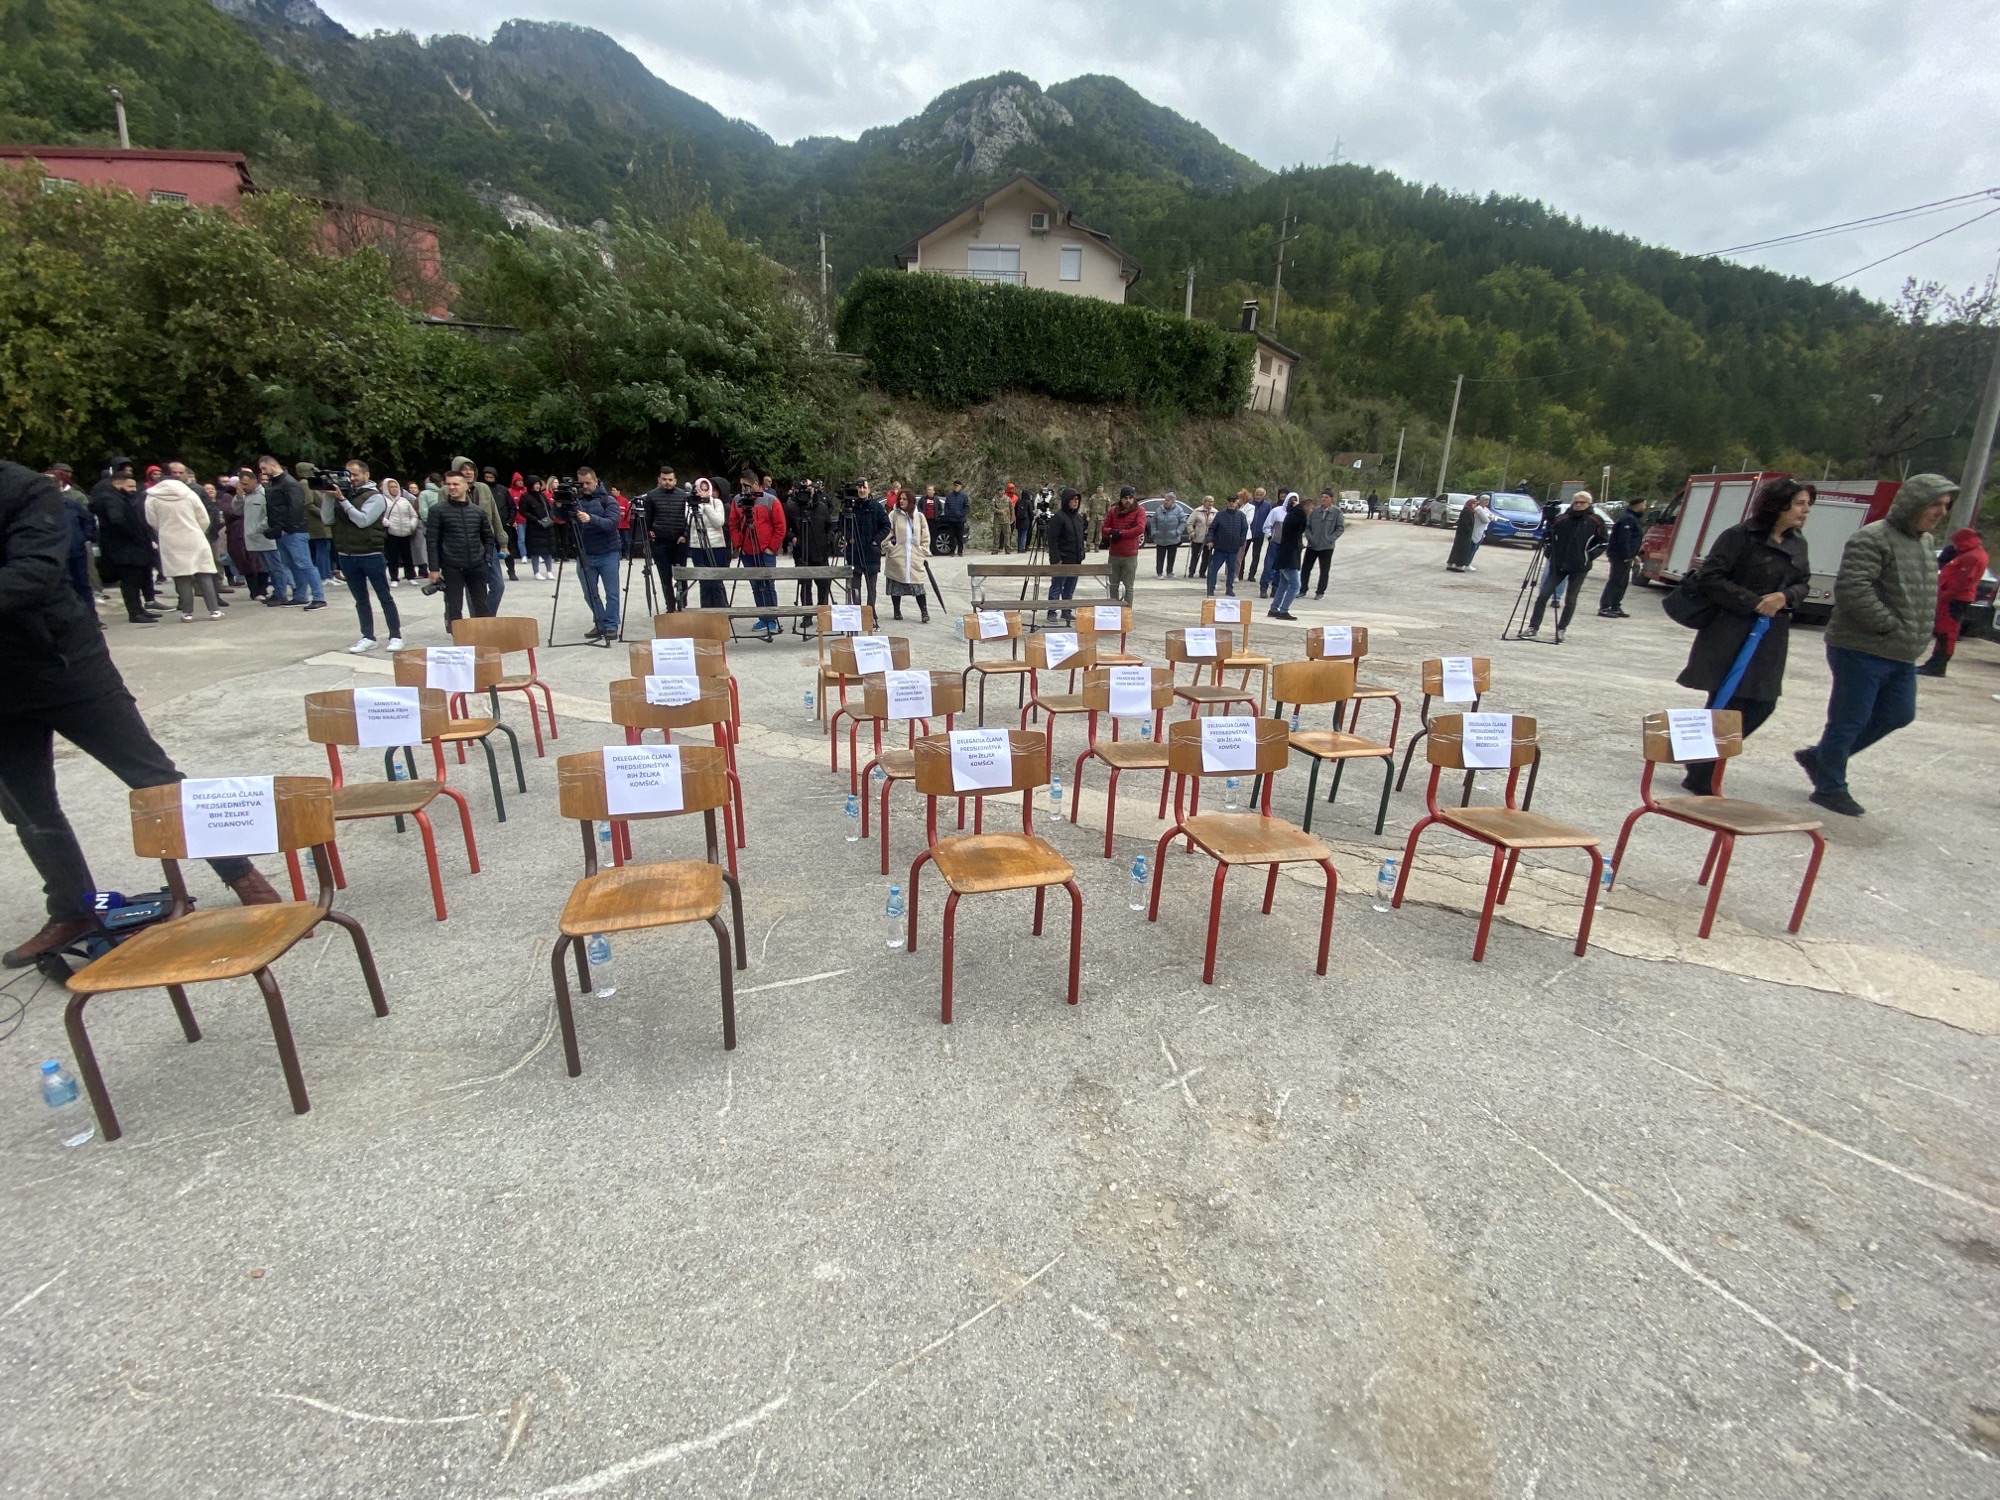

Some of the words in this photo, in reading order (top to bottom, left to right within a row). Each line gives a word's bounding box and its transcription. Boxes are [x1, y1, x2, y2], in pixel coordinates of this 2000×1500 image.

[959, 744, 1002, 752] PREDSJEDNIŠTVA
[616, 762, 670, 771] PREDSJEDNIŠTVA
[639, 771, 661, 779] ŽELJKA
[192, 792, 237, 800] DELEGACIJA
[238, 790, 265, 798] ČLANA
[195, 800, 262, 810] PREDSJEDNIŠTVA
[224, 810, 251, 818] ŽELJKE
[207, 819, 255, 829] CVIJANOVIĆ
